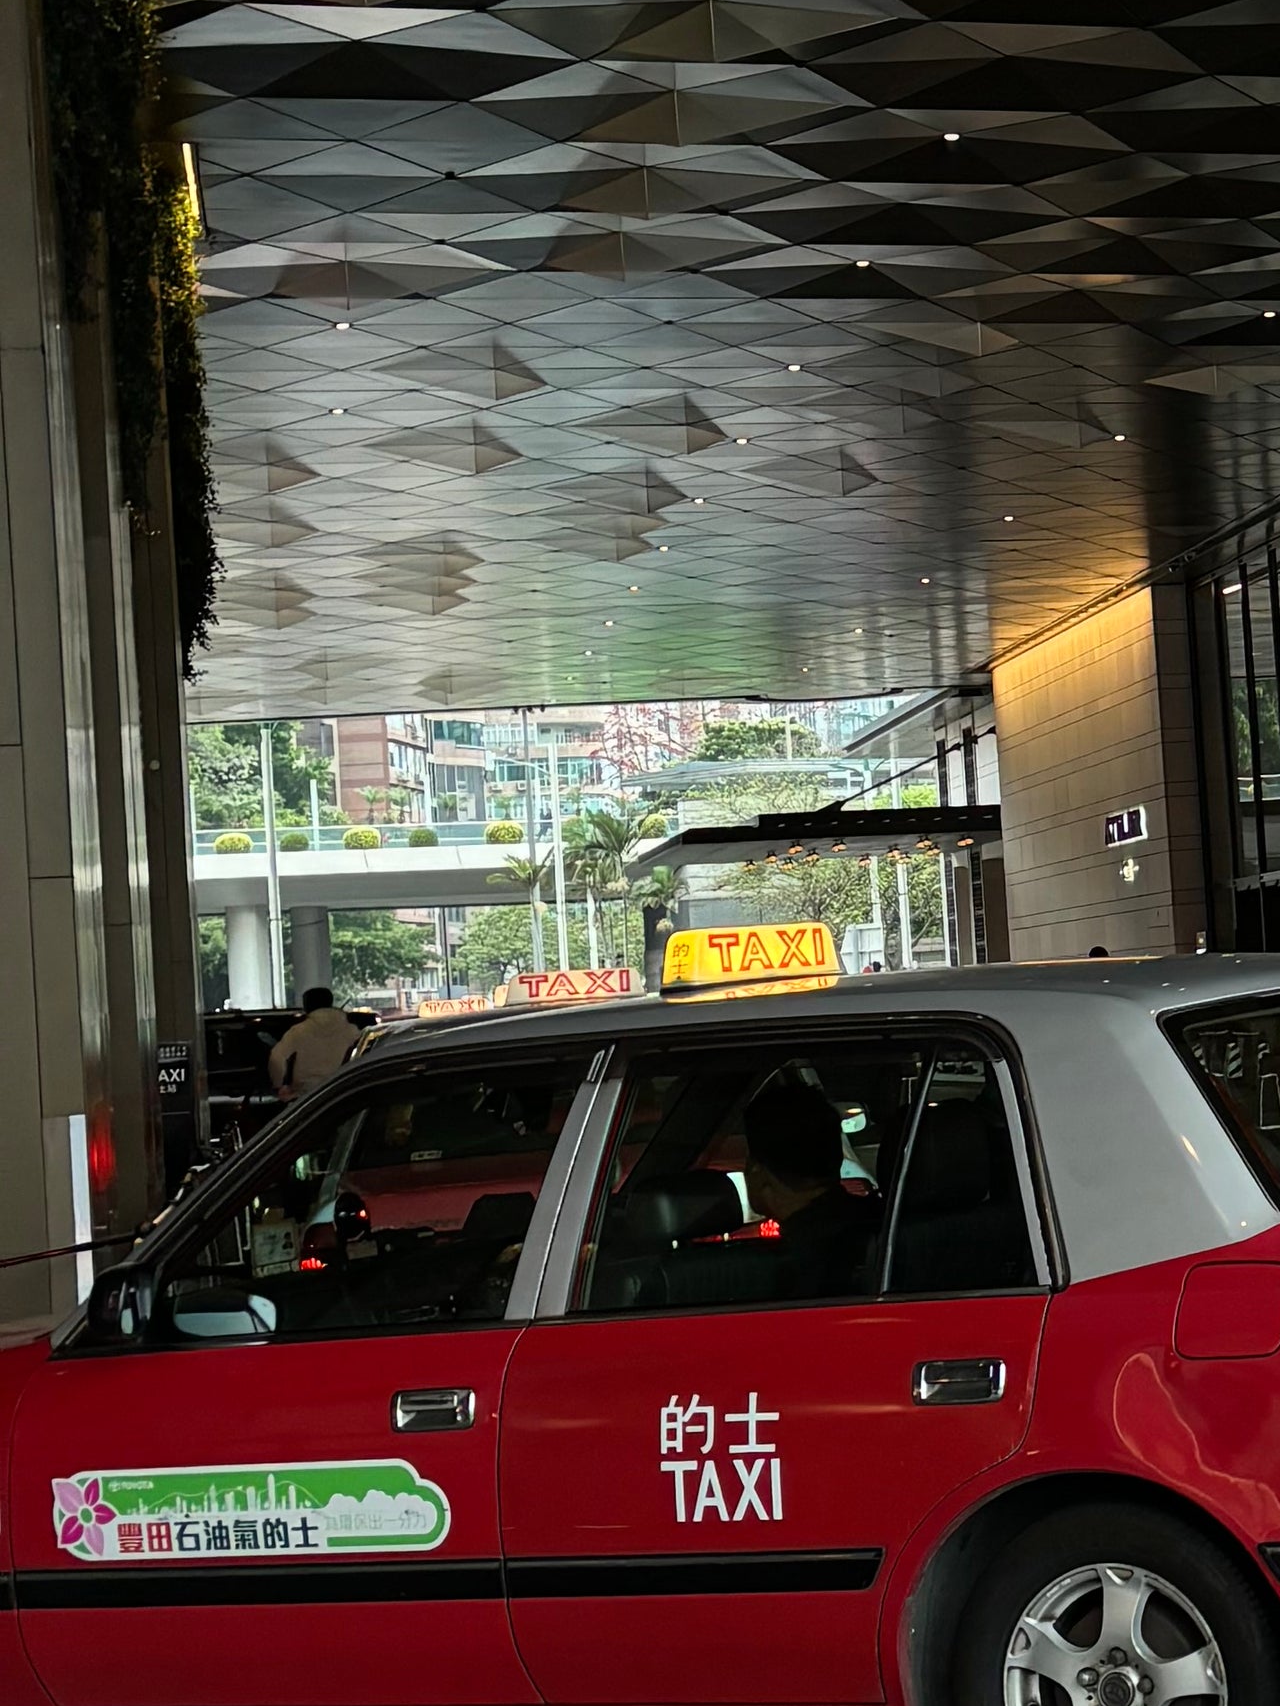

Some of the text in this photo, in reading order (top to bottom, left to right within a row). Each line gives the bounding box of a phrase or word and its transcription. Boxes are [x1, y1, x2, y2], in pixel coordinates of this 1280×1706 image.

[671, 943, 691, 976] 的士
[708, 927, 826, 973] TAXI
[518, 968, 630, 998] TAXI
[425, 998, 487, 1014] TAXI
[158, 1069, 185, 1082] AXI
[660, 1391, 780, 1454] 的士
[660, 1458, 783, 1522] TAXI
[117, 1515, 320, 1554] 豐田石油氣的士
